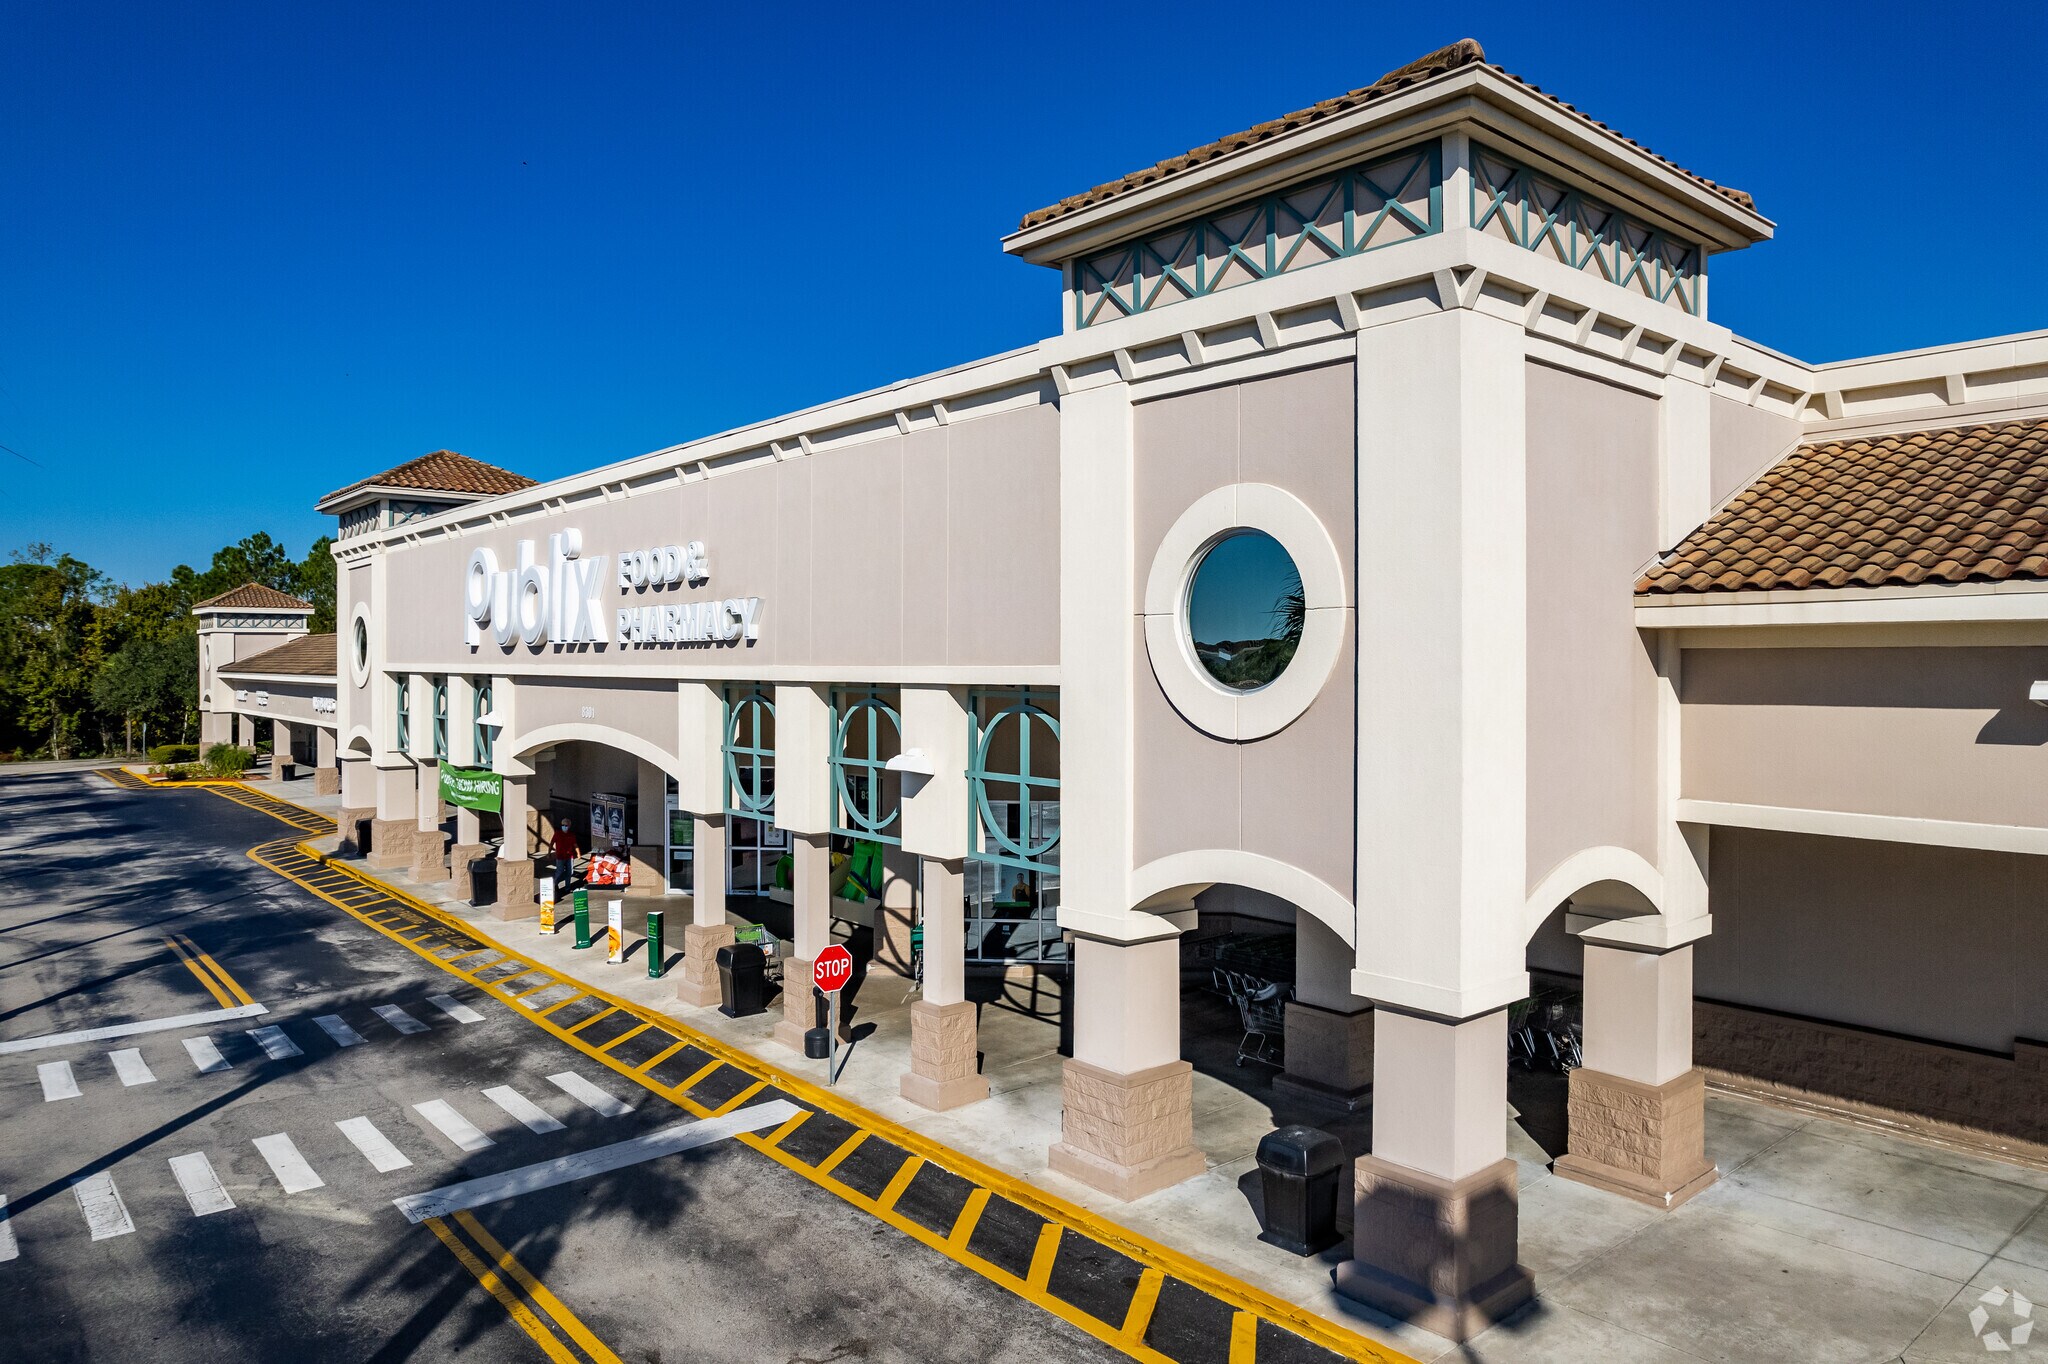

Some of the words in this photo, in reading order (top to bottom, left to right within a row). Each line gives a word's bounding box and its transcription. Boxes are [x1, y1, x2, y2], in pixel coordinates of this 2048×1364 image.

[464, 527, 610, 648] Publix
[619, 545, 687, 588] FOOD
[686, 540, 710, 582] &
[617, 597, 766, 644] PHARMACY
[474, 780, 500, 796] HIRING
[816, 958, 850, 979] STOP
